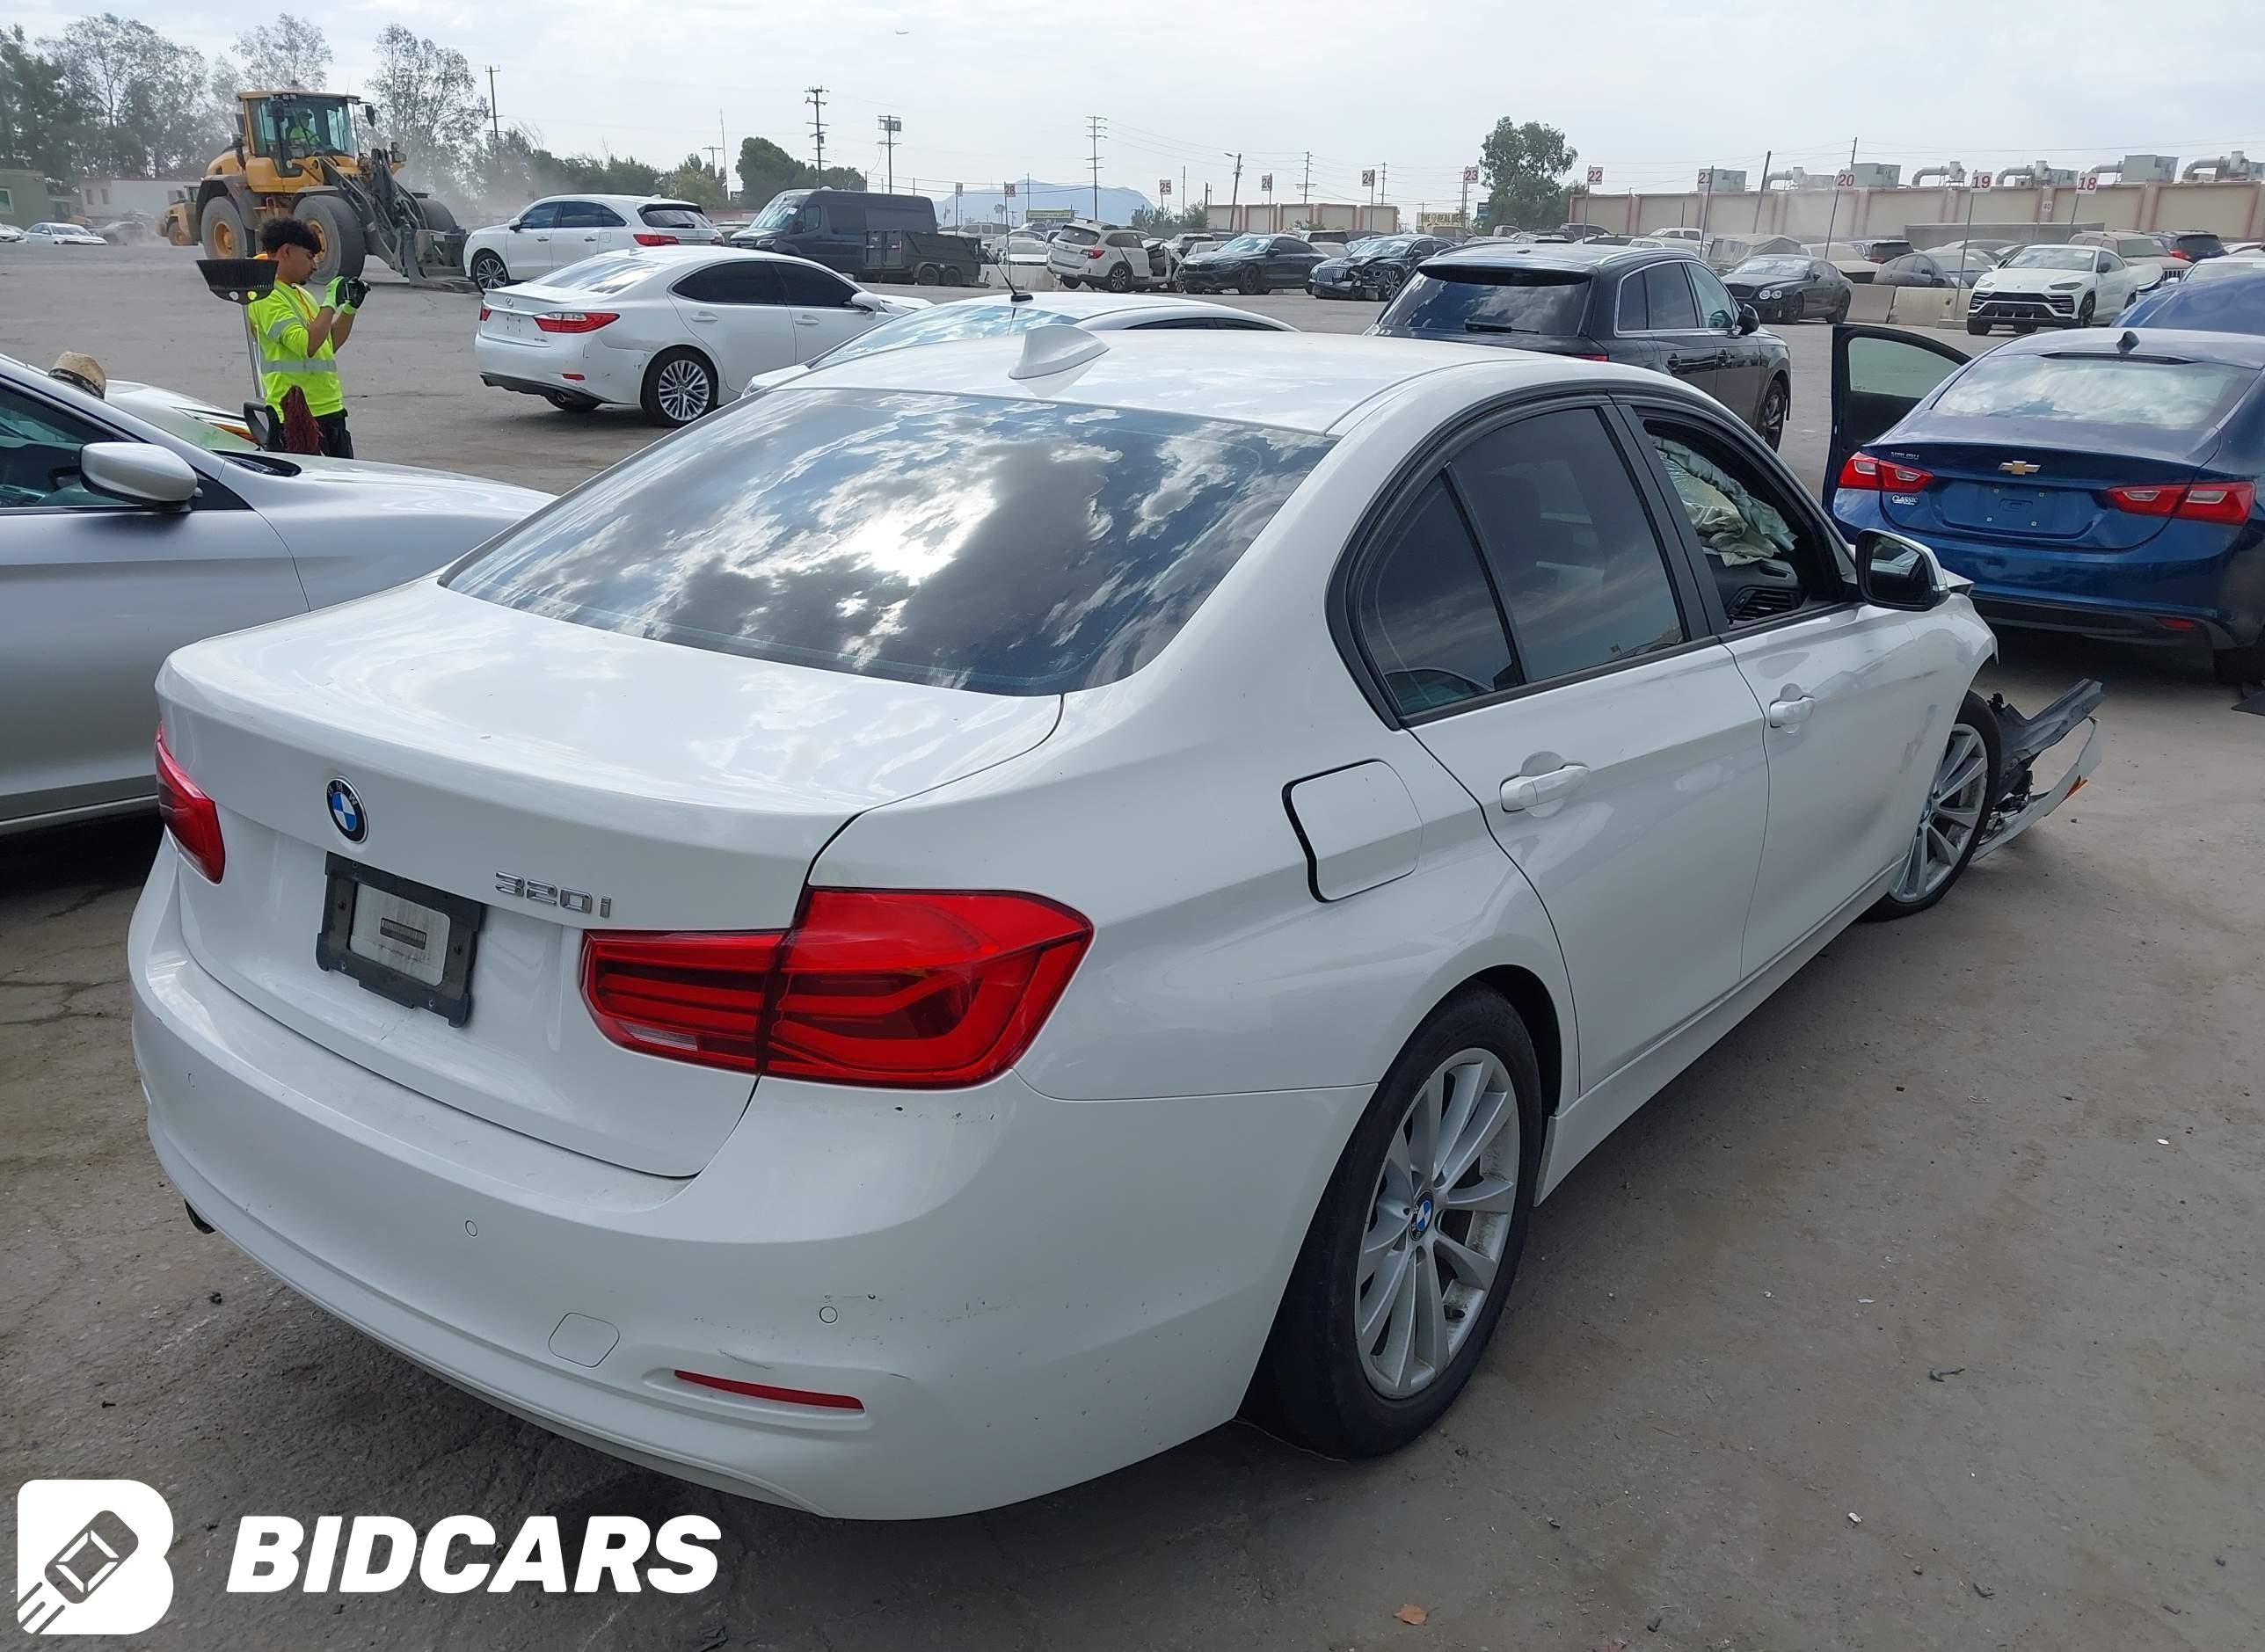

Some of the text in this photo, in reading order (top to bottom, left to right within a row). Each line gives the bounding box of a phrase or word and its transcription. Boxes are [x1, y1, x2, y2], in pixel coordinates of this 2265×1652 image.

[1465, 171, 1479, 181] 23
[1588, 171, 1603, 182] 22
[1698, 171, 1711, 184] 21
[1838, 174, 1854, 187] 20
[1972, 175, 1991, 189] 19
[1160, 183, 1171, 193] 25
[2078, 177, 2097, 191] 18
[1892, 494, 1919, 503] CLASSIC
[495, 871, 612, 919] 320i
